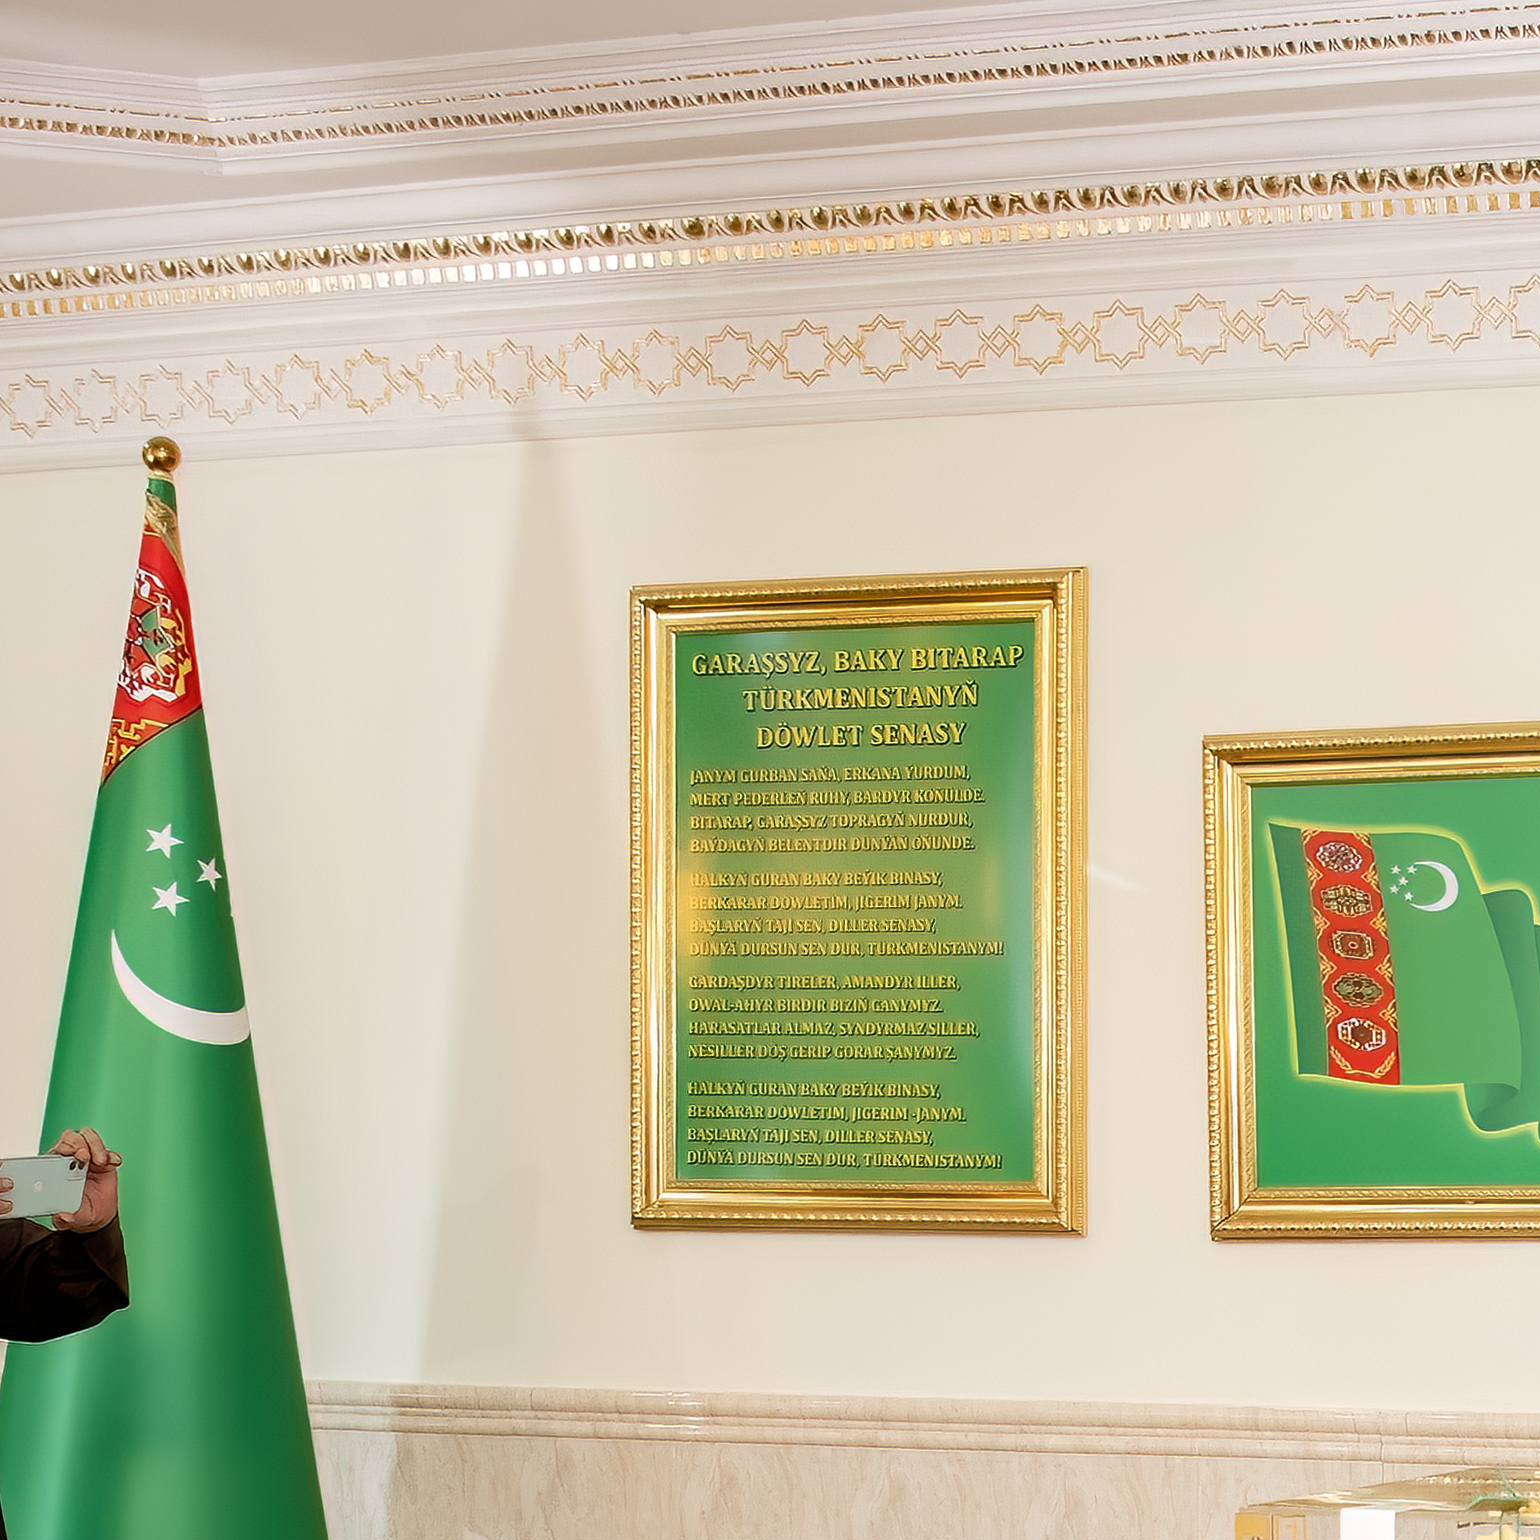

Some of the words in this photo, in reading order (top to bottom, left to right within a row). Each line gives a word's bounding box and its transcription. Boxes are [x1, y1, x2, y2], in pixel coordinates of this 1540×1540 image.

[691, 650, 827, 680] GARAŞSYZ,
[833, 648, 904, 673] BAKY
[910, 645, 1024, 671] BITARAP
[742, 680, 978, 713] TÜRKMENISTANYŇ
[756, 722, 863, 749] DÖWLET
[870, 722, 967, 747] SENASY
